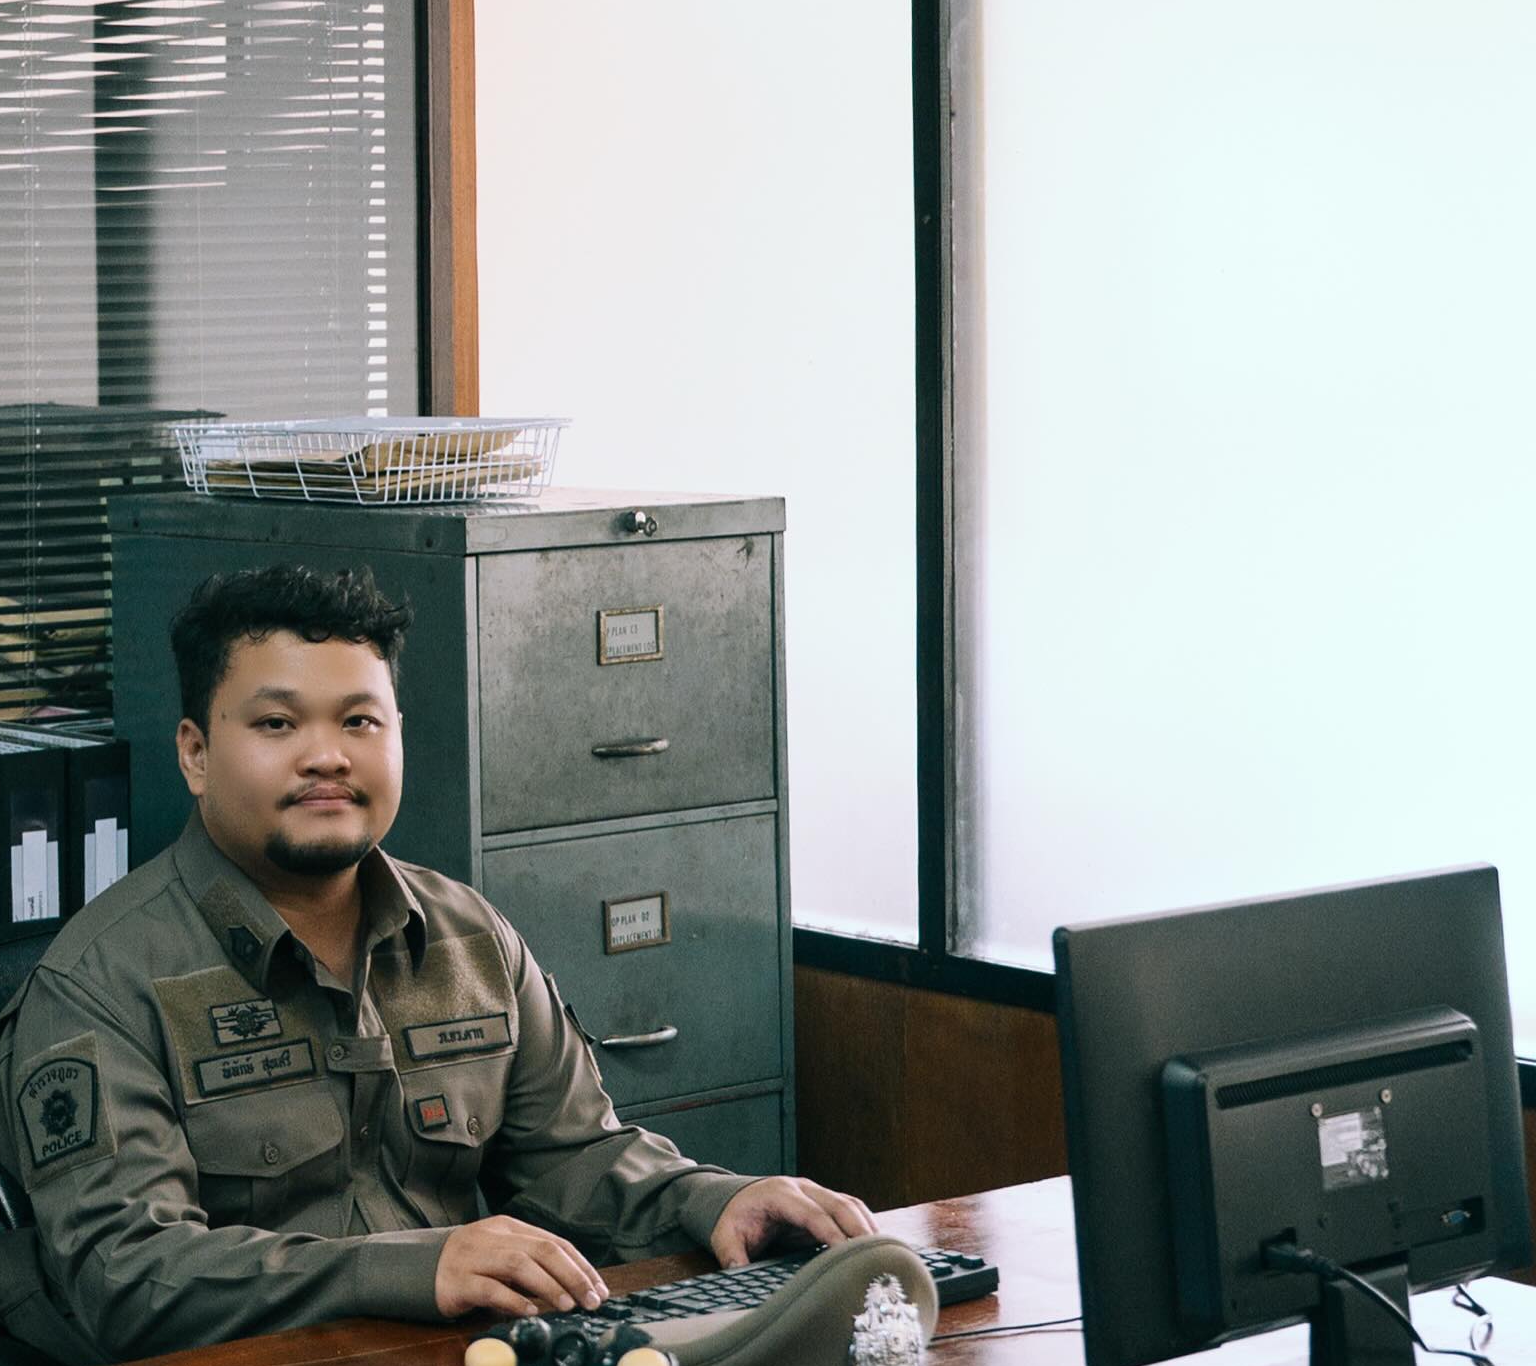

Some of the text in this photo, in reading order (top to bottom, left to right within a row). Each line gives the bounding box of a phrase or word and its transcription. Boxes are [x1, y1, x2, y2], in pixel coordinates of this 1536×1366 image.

[29, 1066, 79, 1099] ตำรวจภูธร
[42, 1130, 83, 1157] POLICE
